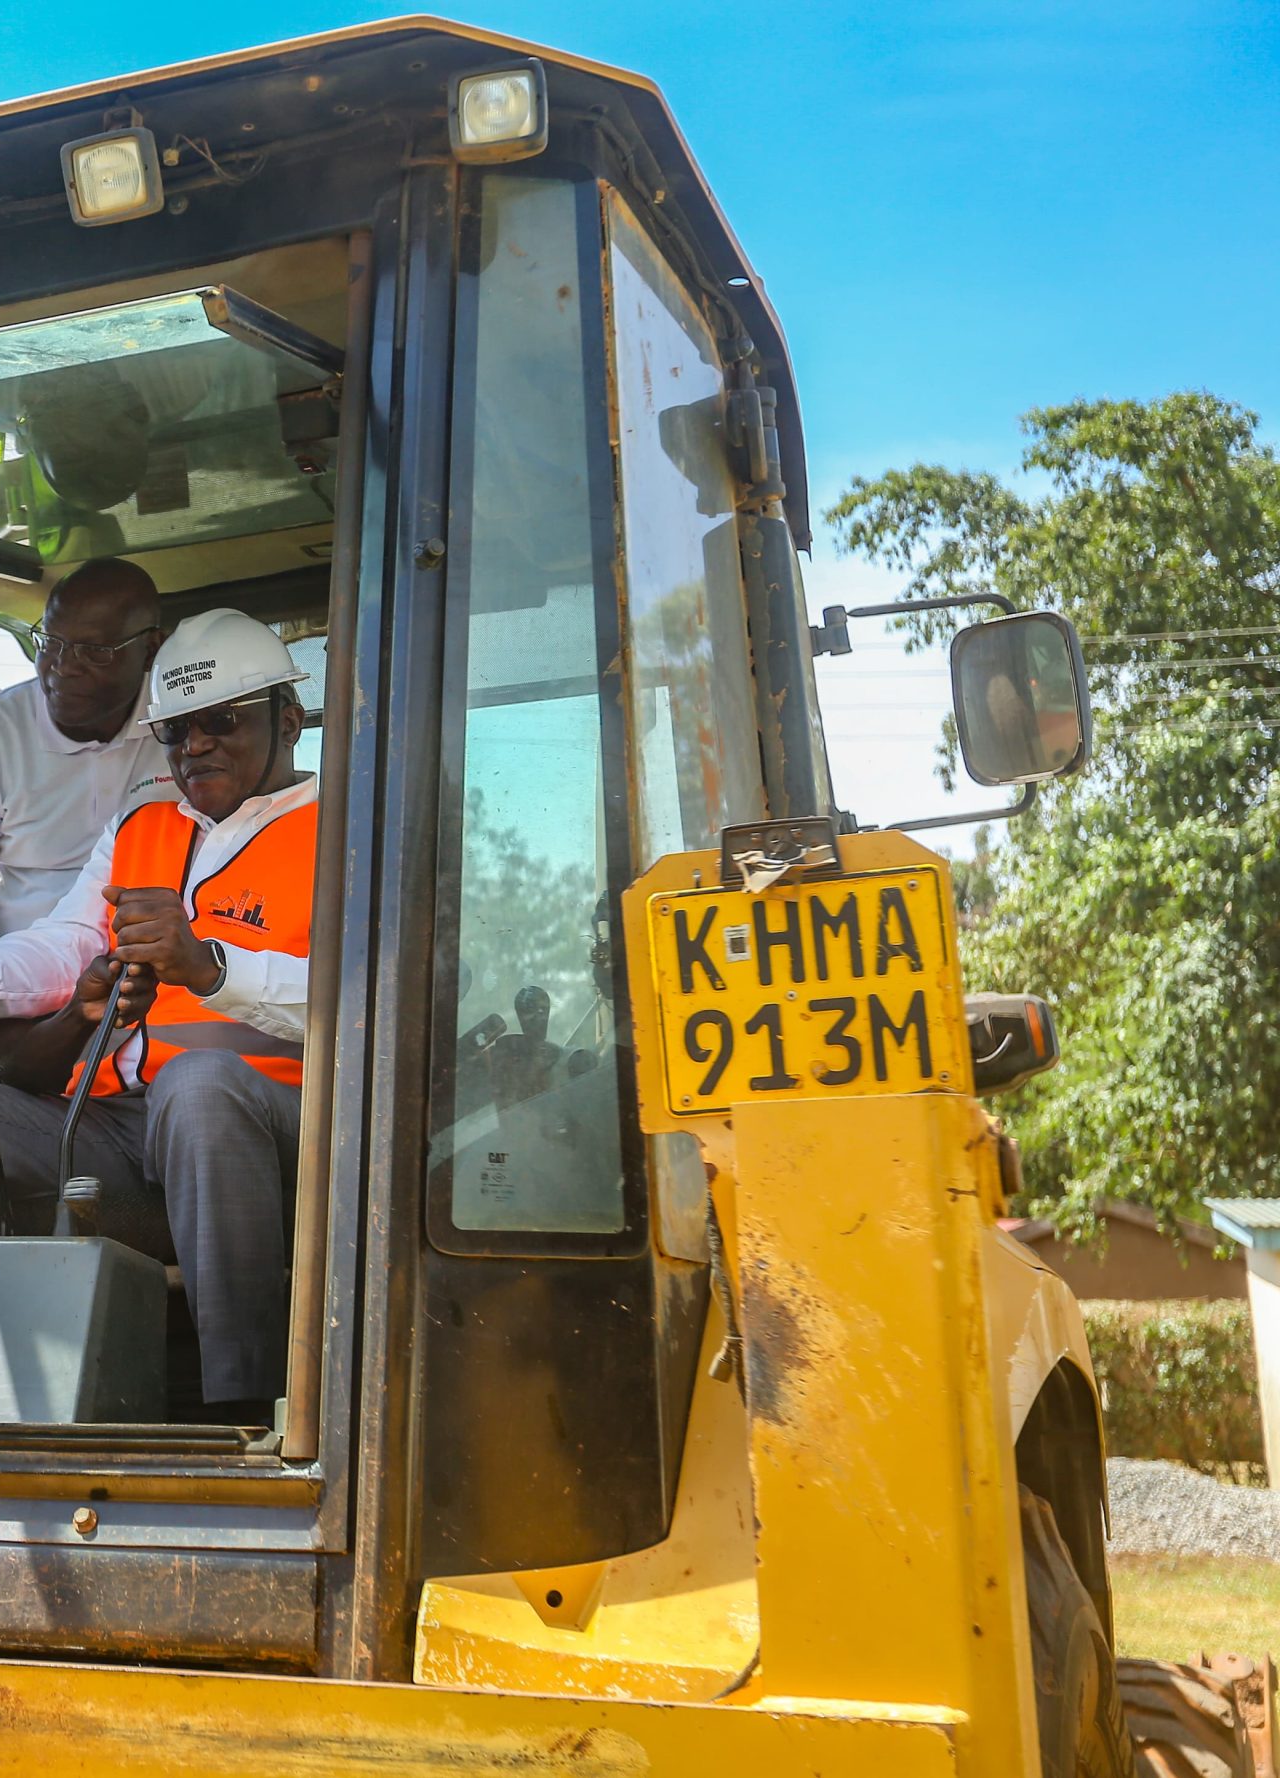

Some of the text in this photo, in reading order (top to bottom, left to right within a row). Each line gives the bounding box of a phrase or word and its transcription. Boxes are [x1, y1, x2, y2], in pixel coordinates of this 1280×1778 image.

[183, 659, 216, 674] BUILDING
[166, 670, 213, 691] CONTRACTORS
[182, 685, 196, 697] LTD
[683, 989, 933, 1096] 913M
[488, 1152, 507, 1164] CAT
